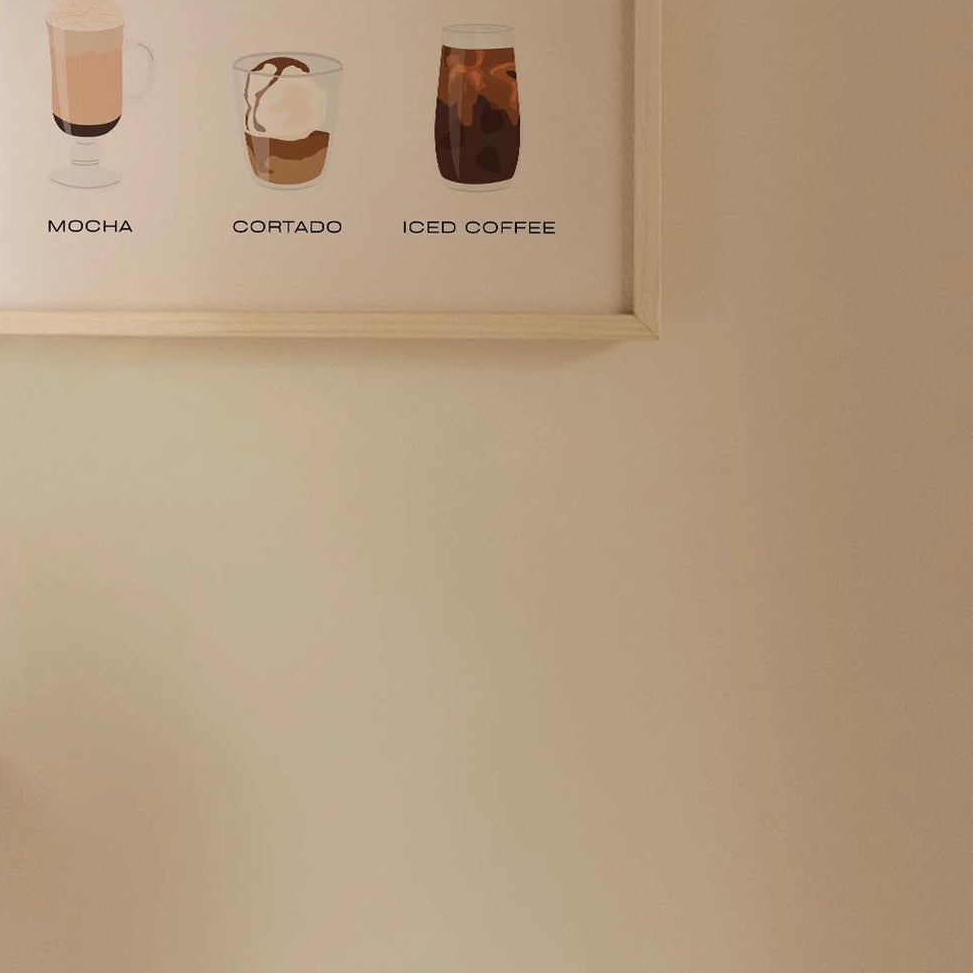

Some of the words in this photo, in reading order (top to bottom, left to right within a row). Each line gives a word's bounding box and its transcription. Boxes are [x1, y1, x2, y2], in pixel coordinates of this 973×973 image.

[48, 219, 133, 233] MOCHA
[232, 219, 342, 234] CORTADO
[403, 220, 457, 234] ICED
[464, 220, 556, 235] COFFEE
